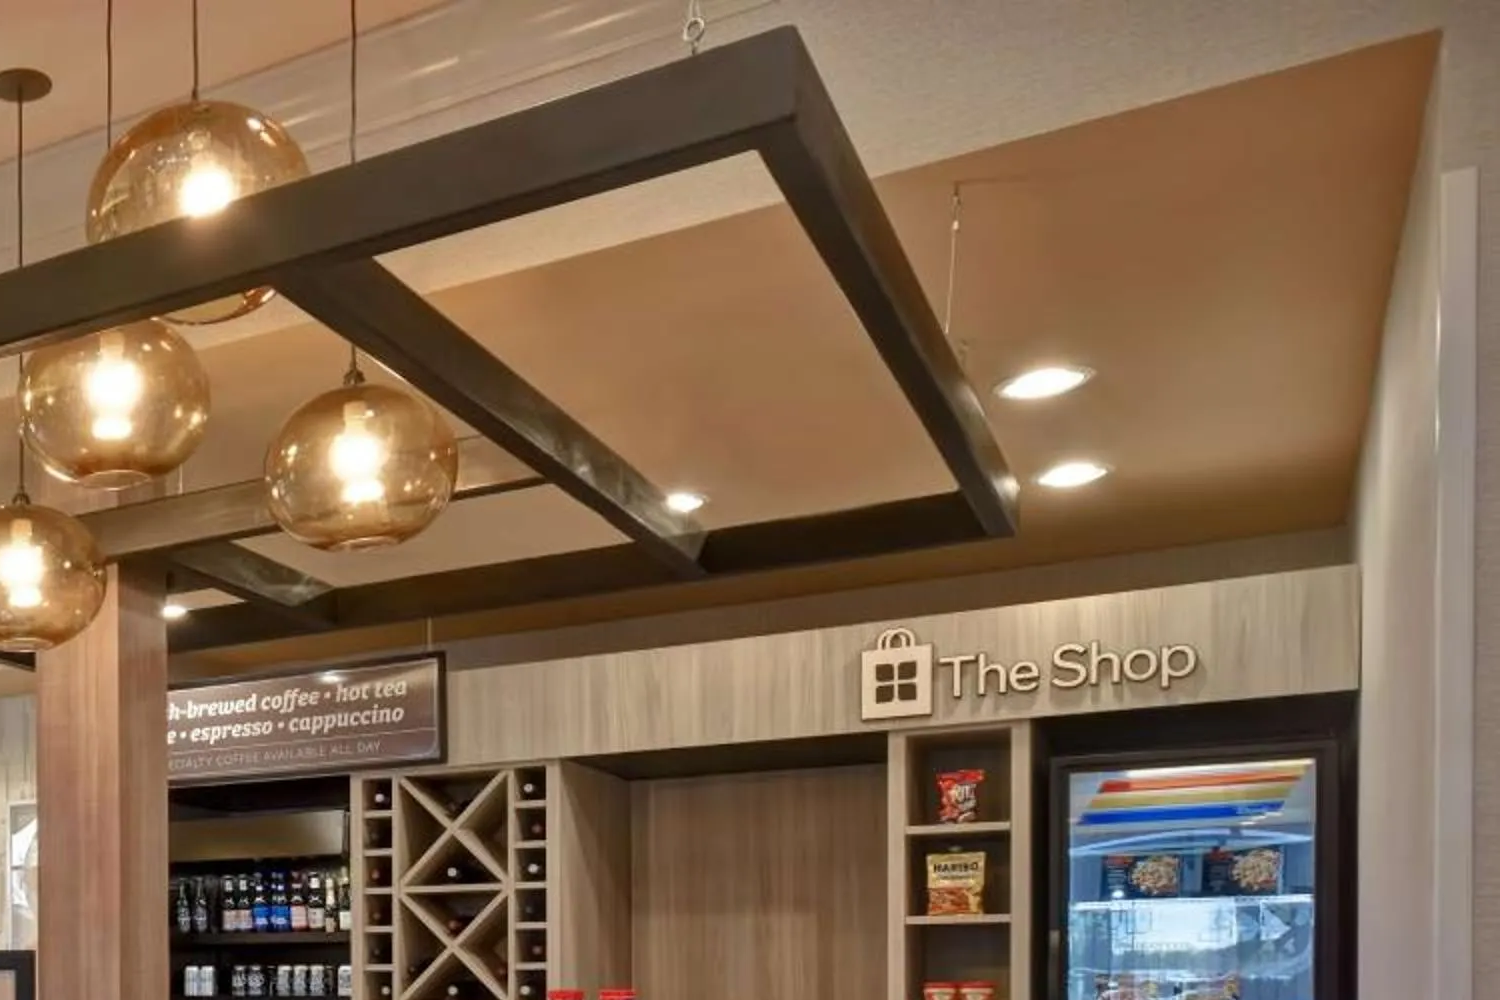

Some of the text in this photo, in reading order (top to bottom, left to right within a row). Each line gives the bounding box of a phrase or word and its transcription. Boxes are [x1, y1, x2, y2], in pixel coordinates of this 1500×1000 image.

[939, 641, 1197, 698] The Shop
[261, 690, 319, 713] coffee
[336, 682, 369, 703] hot
[374, 680, 407, 697] tea
[190, 719, 273, 745] espresso
[288, 704, 405, 734] cappuccino
